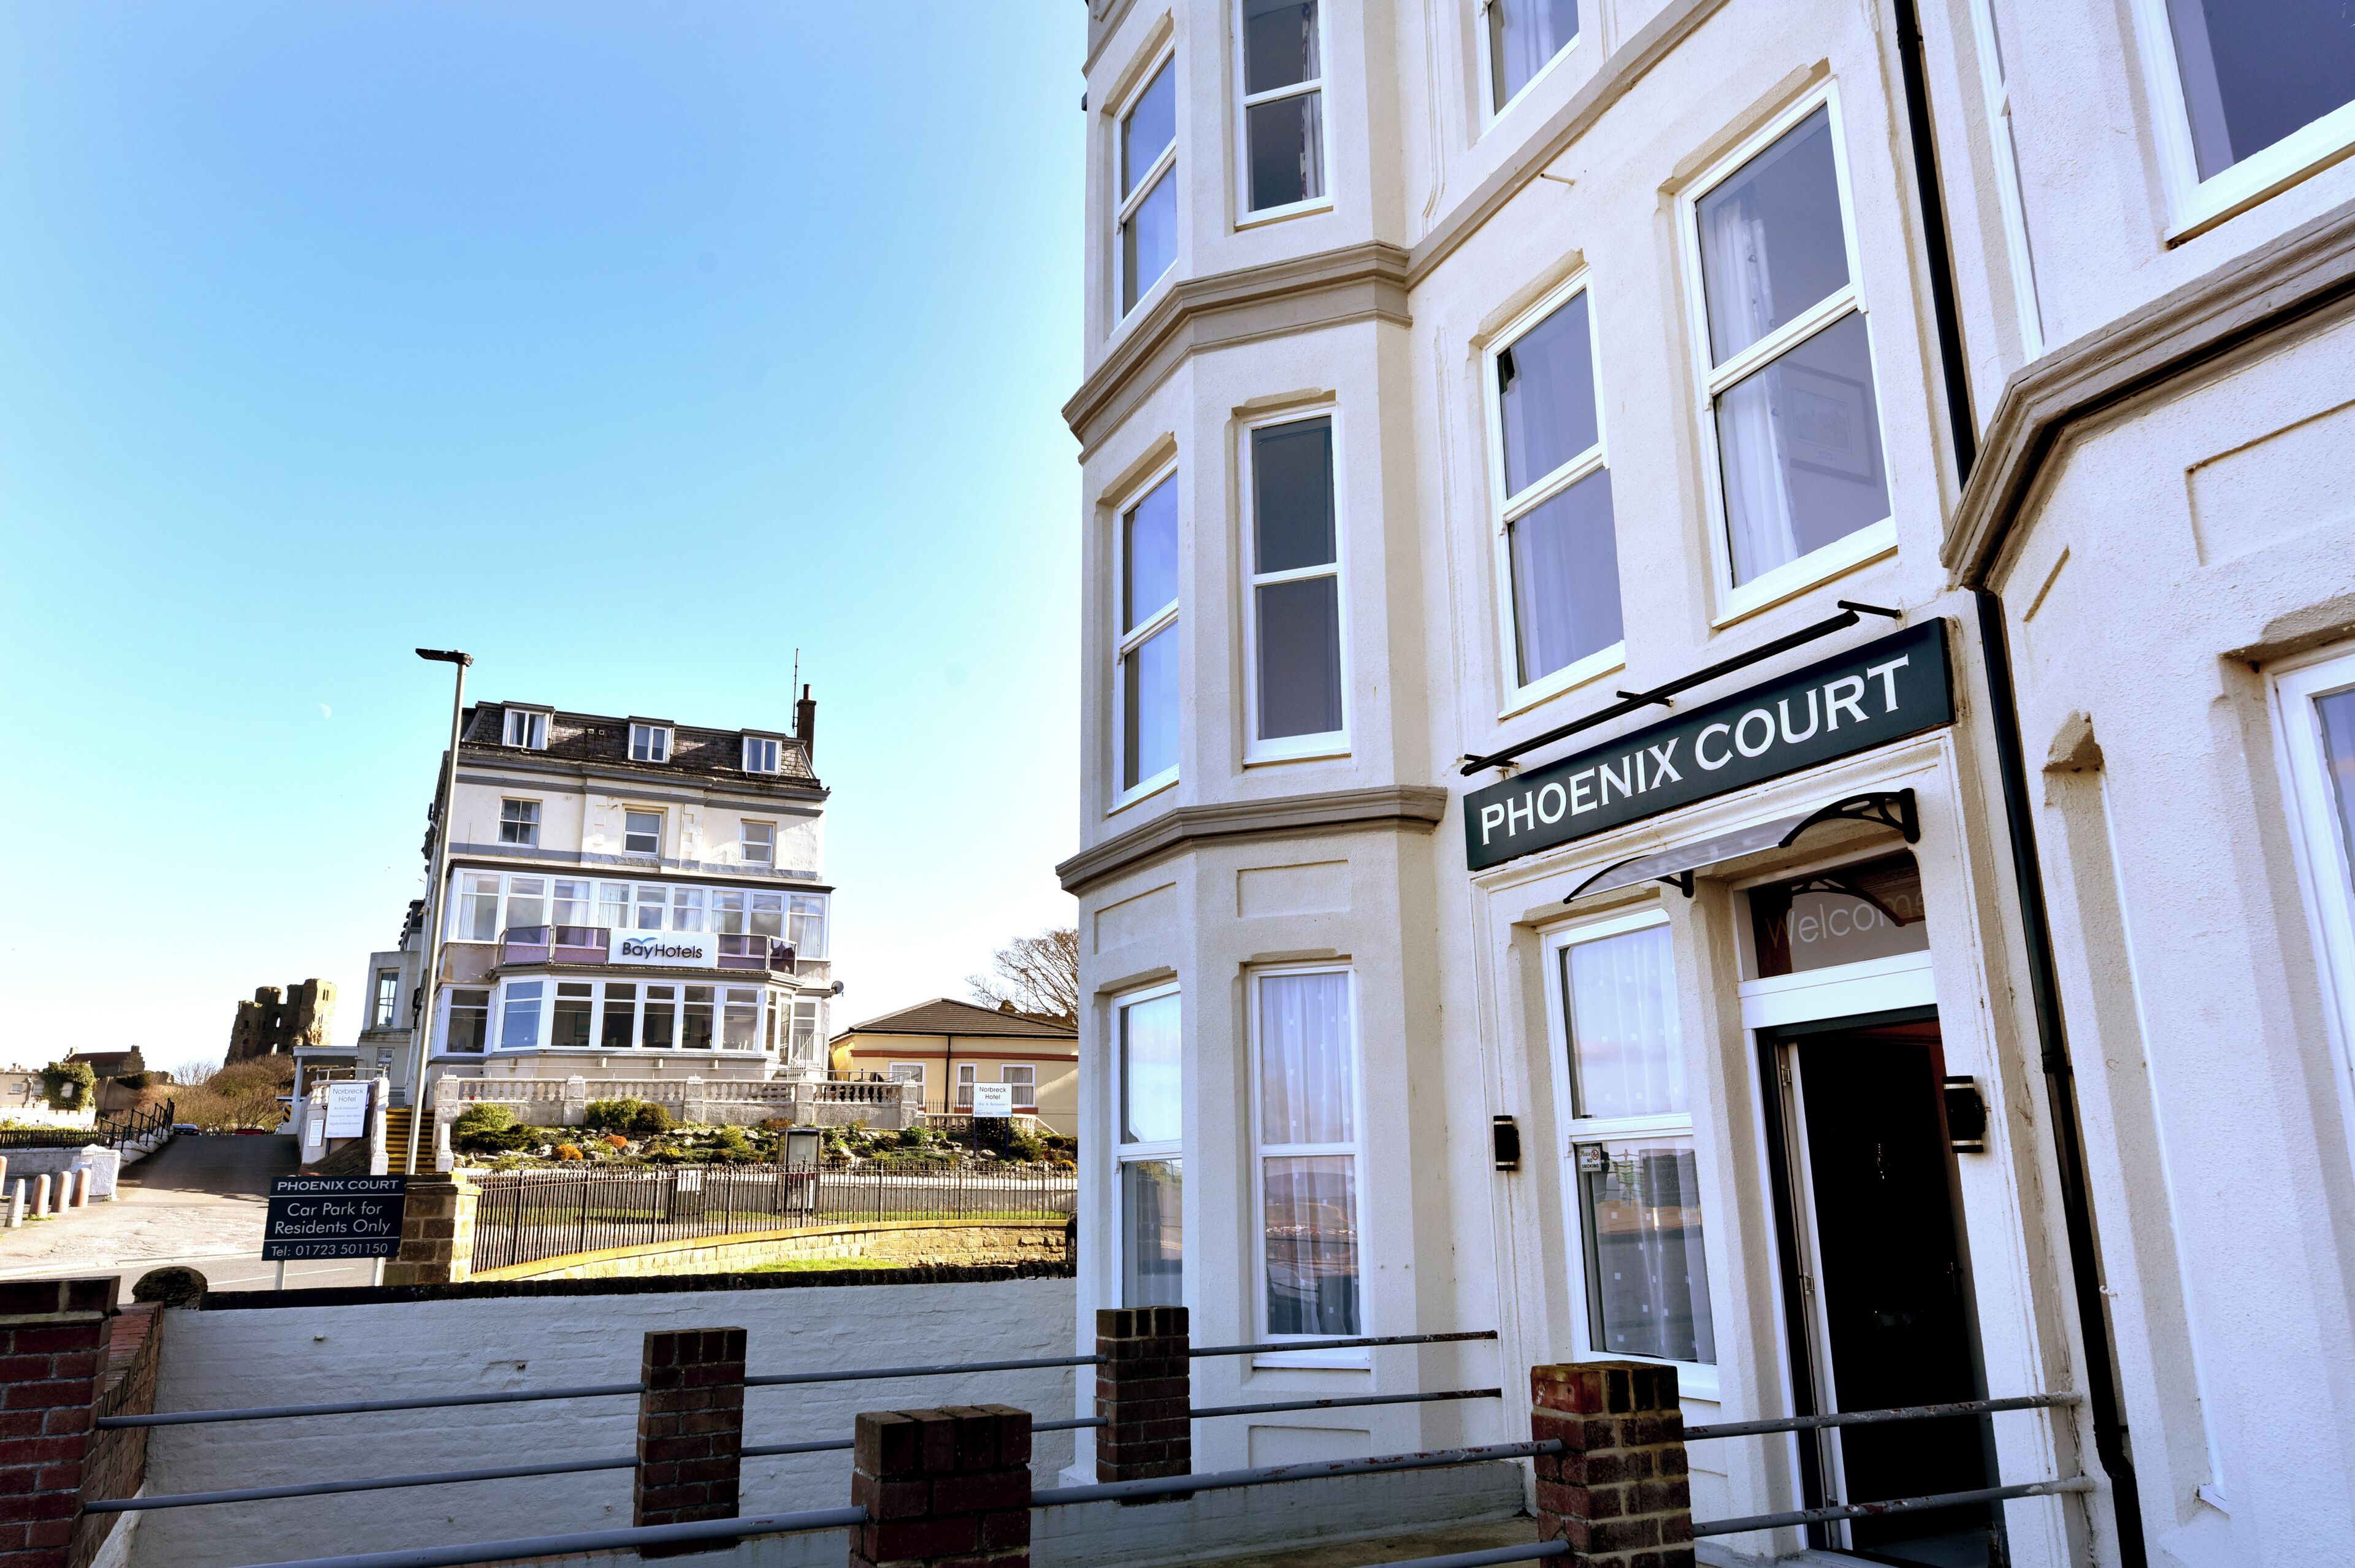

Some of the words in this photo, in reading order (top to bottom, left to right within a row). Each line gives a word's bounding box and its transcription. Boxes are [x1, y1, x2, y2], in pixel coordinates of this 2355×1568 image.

[1480, 737, 1683, 846] PHOENIX
[1695, 653, 1910, 771] COURT
[277, 1180, 345, 1191] PHOENIX
[348, 1180, 399, 1190] COURT
[287, 1203, 317, 1217] Car
[323, 1201, 355, 1215] Park
[361, 1201, 383, 1215] for
[275, 1220, 347, 1234] Residents
[353, 1218, 391, 1235] Only
[271, 1245, 291, 1256] Tel:
[296, 1245, 335, 1256] 01723
[340, 1244, 388, 1255] 501150
